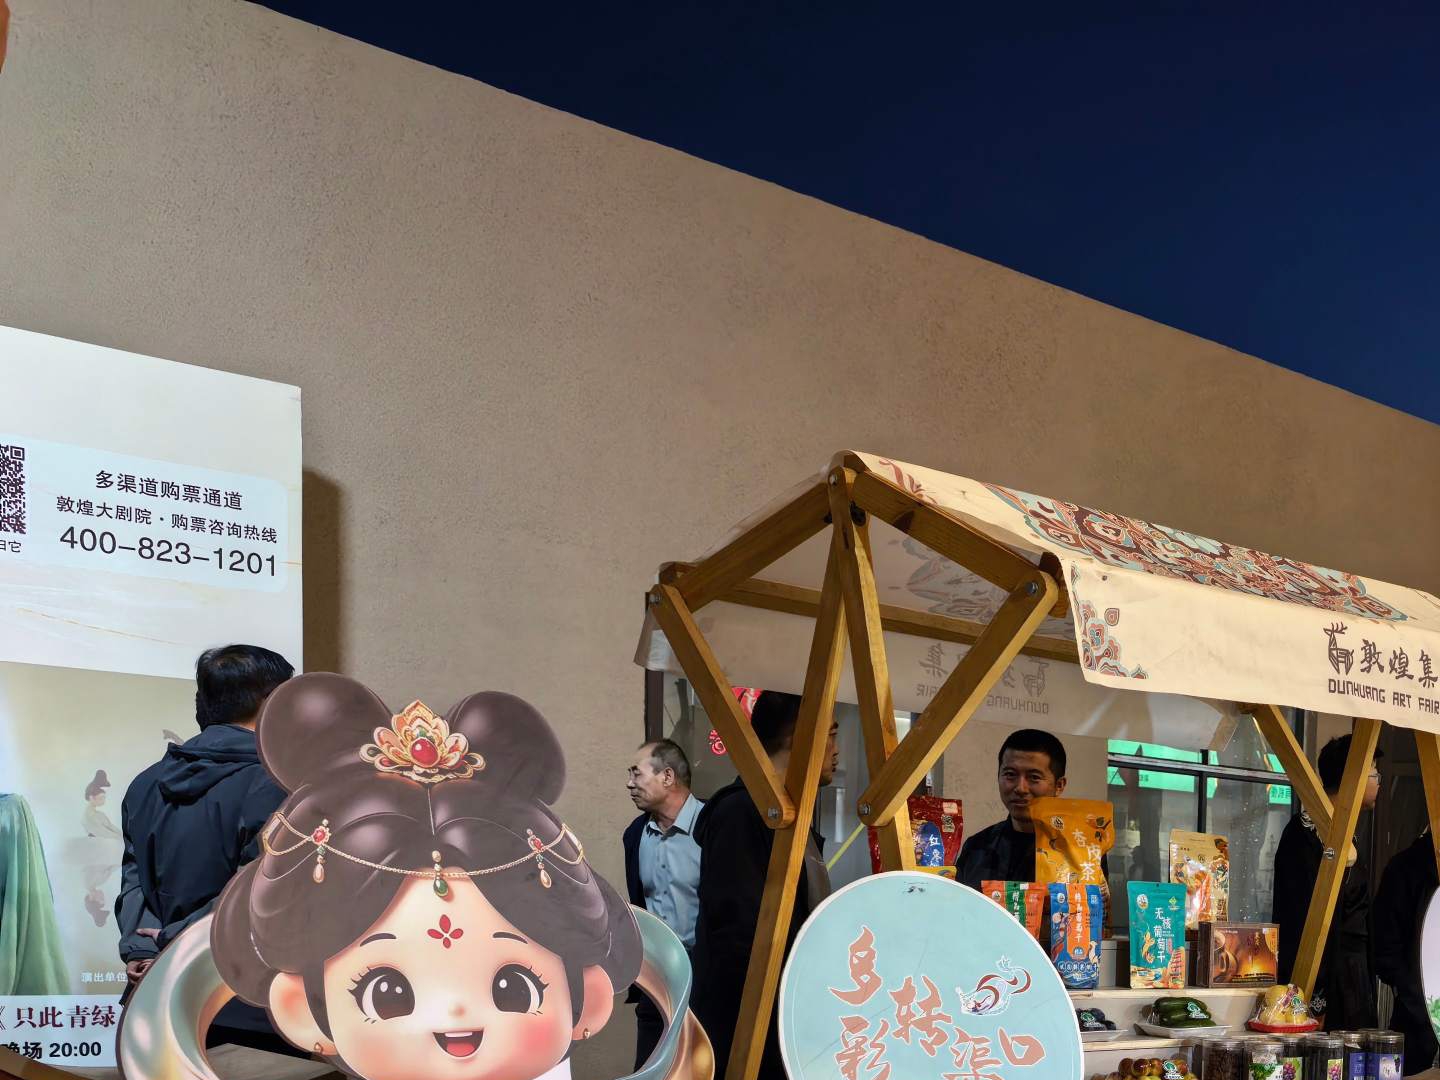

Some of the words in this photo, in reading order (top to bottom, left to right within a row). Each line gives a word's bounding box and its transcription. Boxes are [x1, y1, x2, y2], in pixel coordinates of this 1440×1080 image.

[95, 470, 243, 510] 多渠道购票通道
[59, 526, 276, 577] 400-823-1201
[1360, 639, 1438, 688] 敦煌集
[1328, 679, 1385, 703] DUNHUANG
[1392, 692, 1411, 708] ART
[1418, 697, 1440, 714] FAIR
[1153, 907, 1173, 963] 无核葡萄干
[49, 1041, 102, 1058] 20:00
